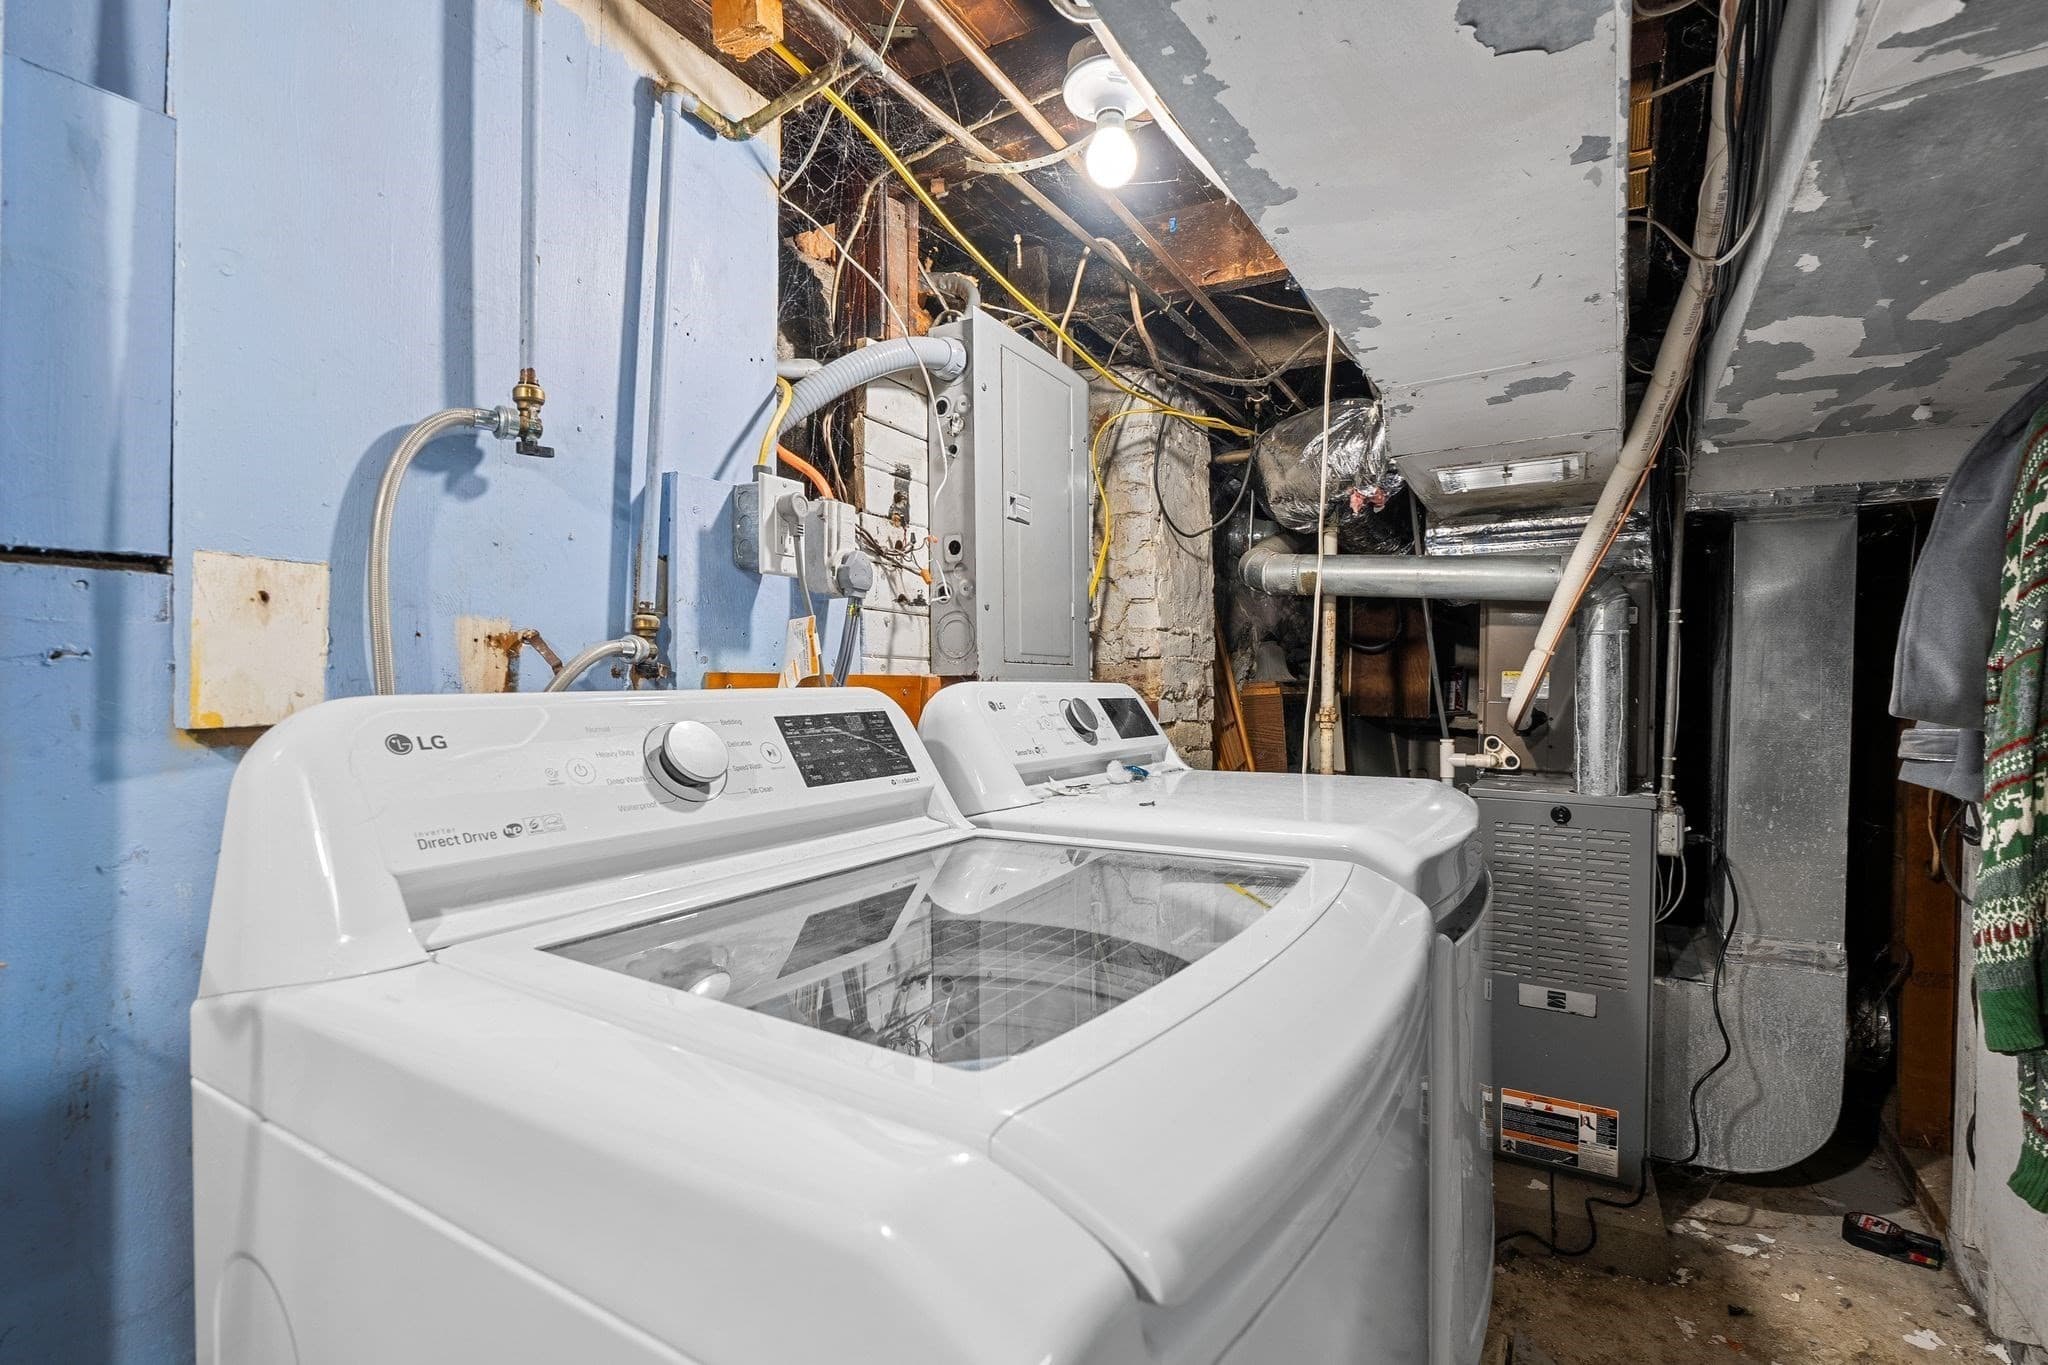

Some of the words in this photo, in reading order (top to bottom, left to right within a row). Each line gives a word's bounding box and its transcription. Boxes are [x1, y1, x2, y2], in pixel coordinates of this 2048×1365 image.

[417, 735, 448, 750] LG
[606, 776, 625, 786] Deep
[617, 799, 658, 813] Waterproof
[417, 835, 462, 851] Direct
[462, 830, 498, 845] Drive
